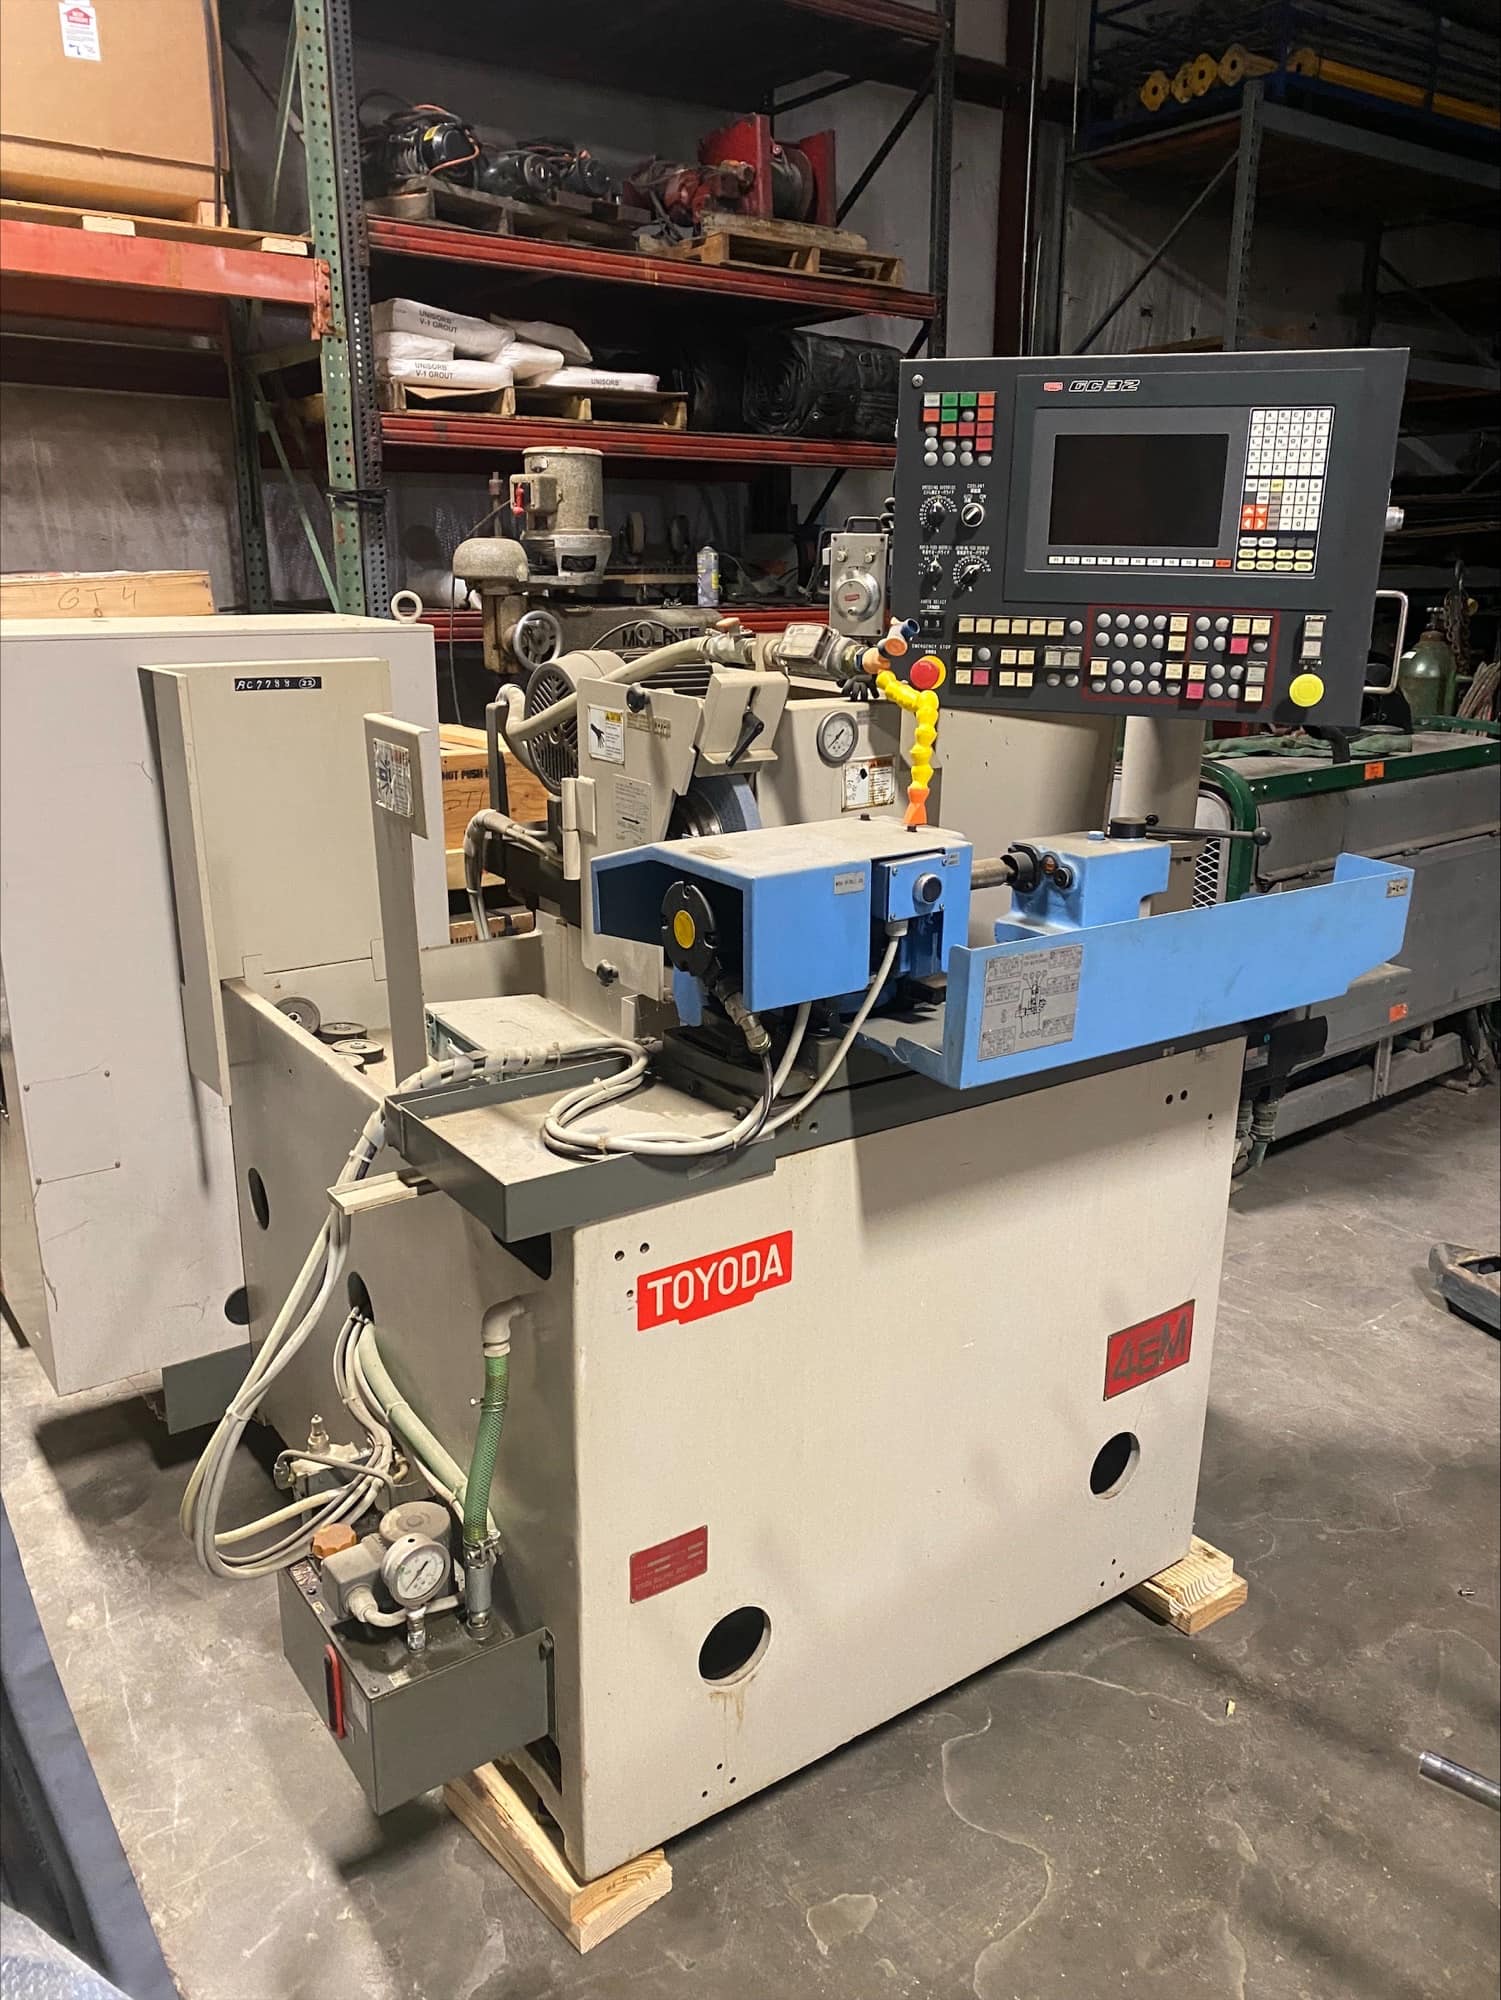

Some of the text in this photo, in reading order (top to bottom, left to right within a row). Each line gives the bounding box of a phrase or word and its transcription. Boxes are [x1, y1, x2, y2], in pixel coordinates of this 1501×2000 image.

[419, 317, 457, 333] V-1 GROUT
[415, 369, 454, 380] V-1 GROUT
[647, 1243, 783, 1317] TOYODA
